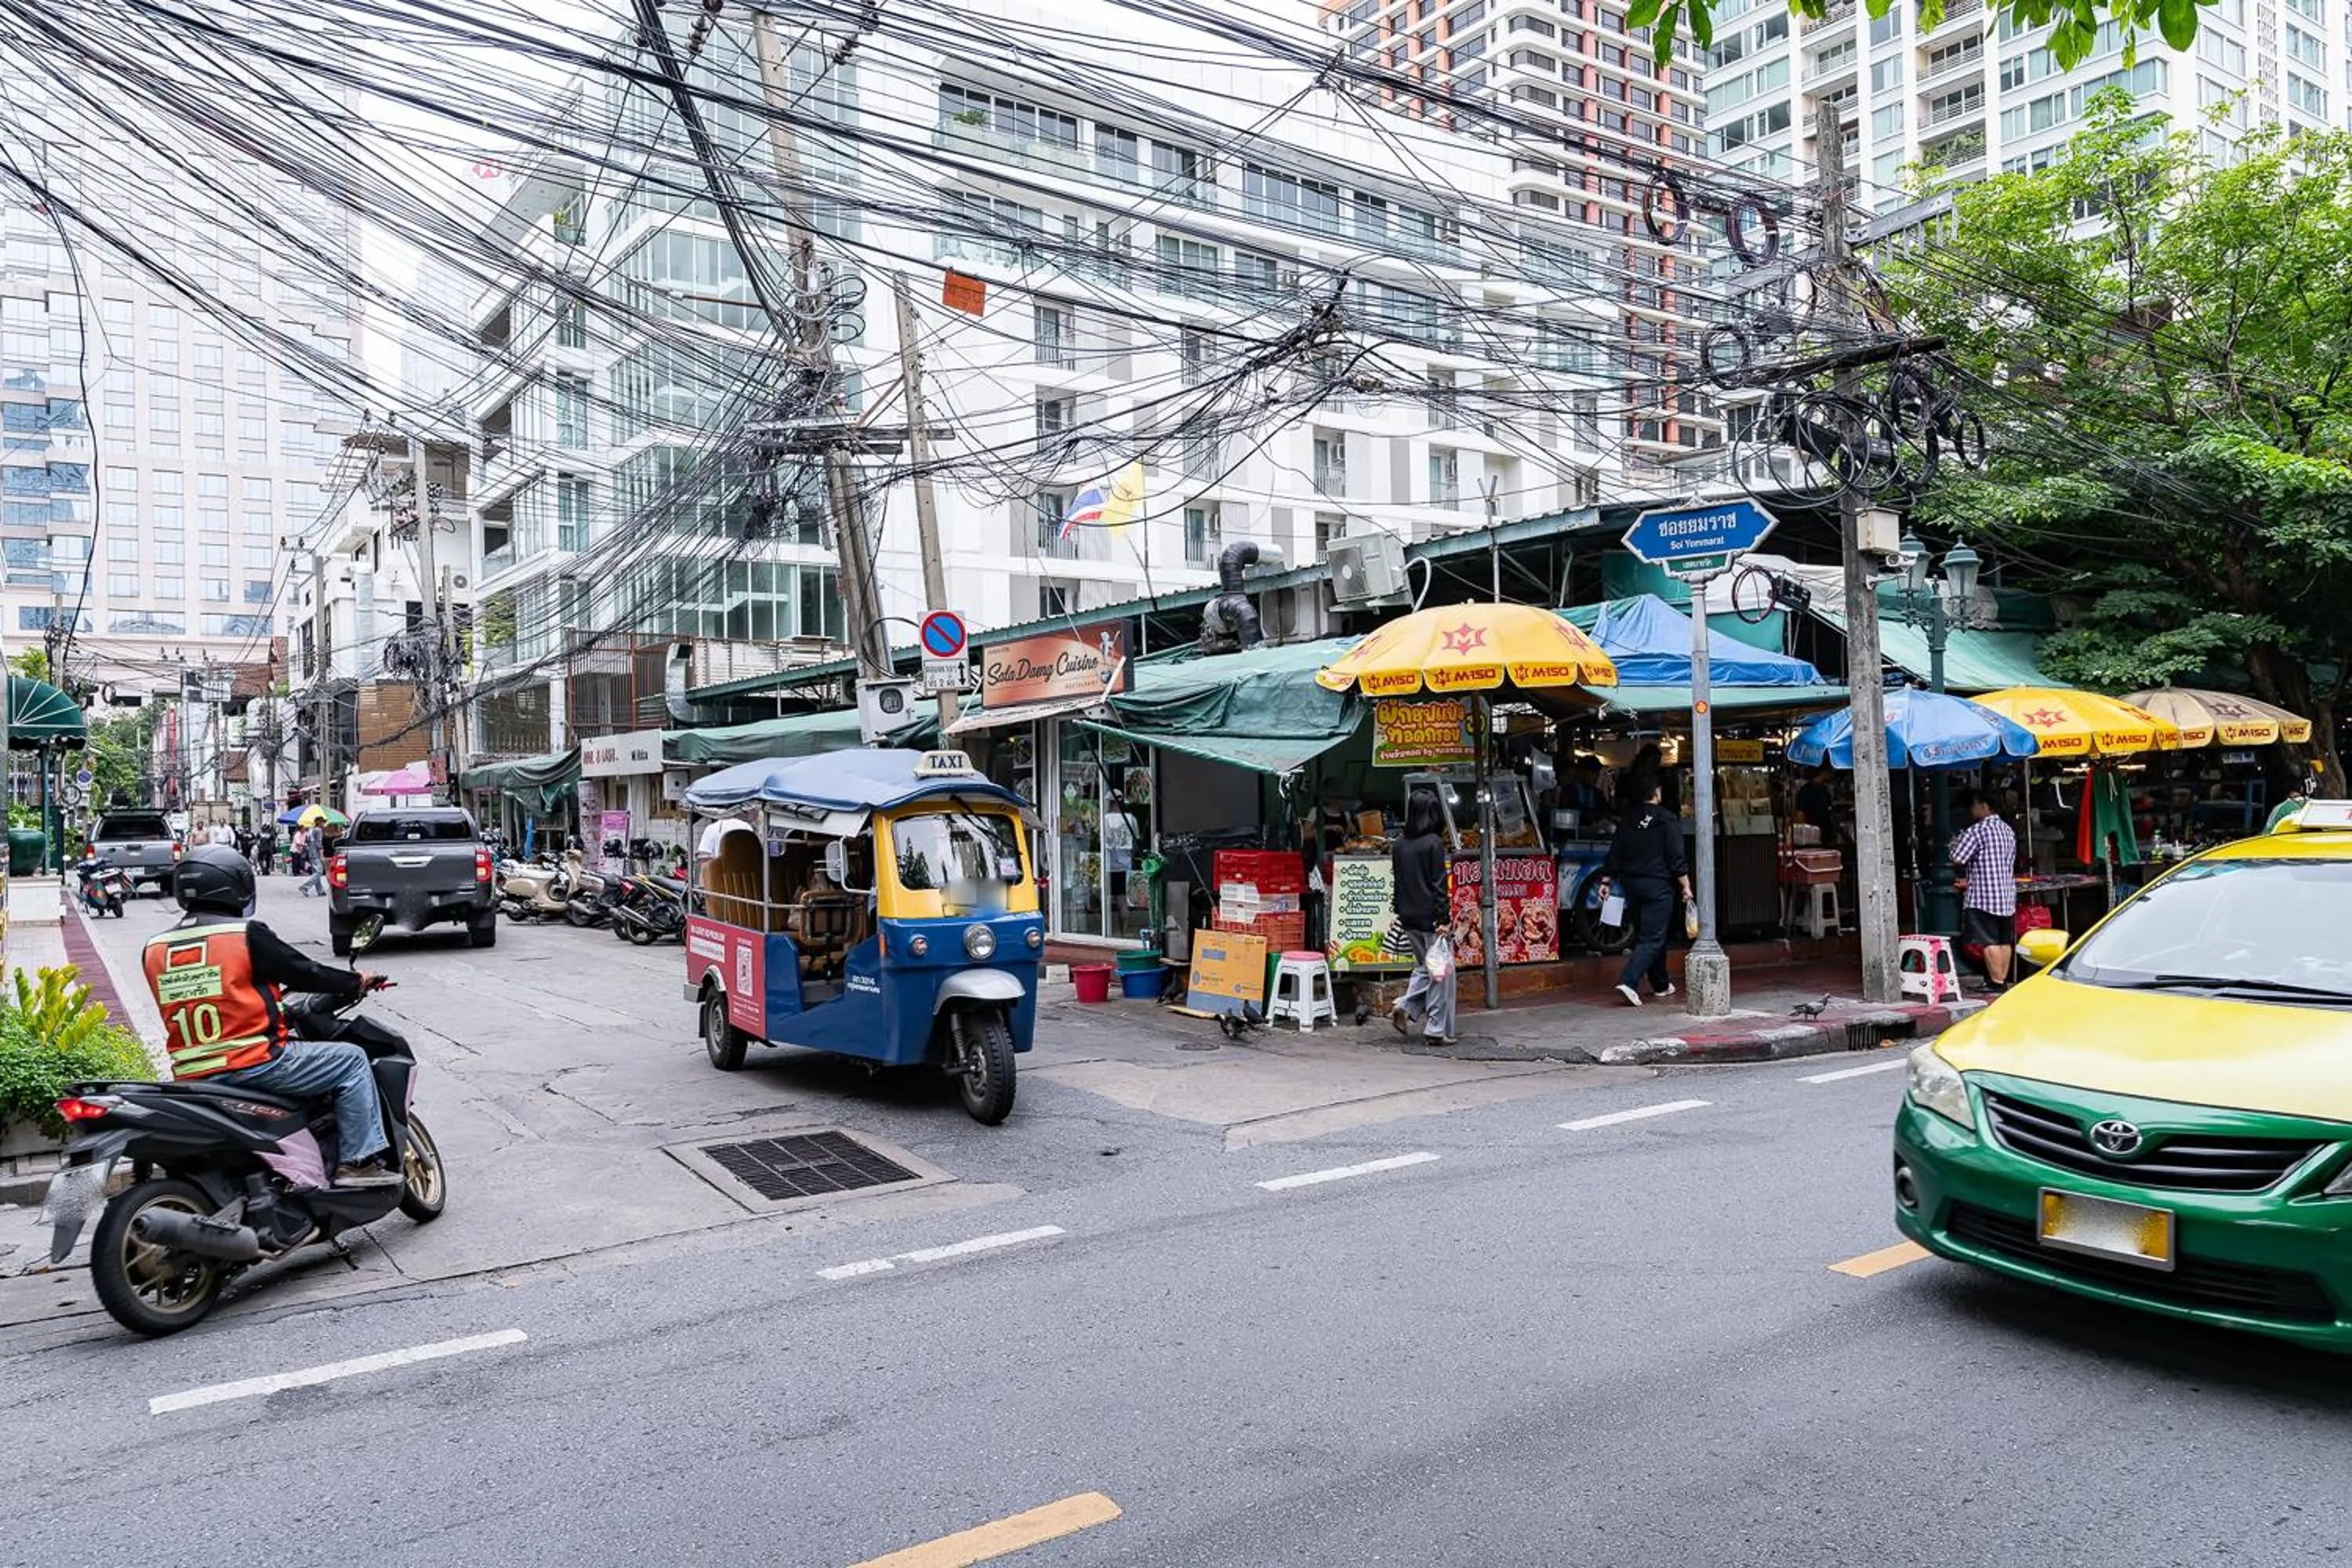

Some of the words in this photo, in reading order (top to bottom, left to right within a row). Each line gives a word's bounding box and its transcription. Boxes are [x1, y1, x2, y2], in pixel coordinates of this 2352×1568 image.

[1658, 512, 1737, 537] ซอยยมราช
[1670, 539, 1683, 550] Soi
[1685, 535, 1725, 549] Yommarat
[1056, 652, 1099, 676] Cuisine
[1386, 726, 1461, 743] ทอดกรอบ
[929, 755, 964, 769] TAXI
[172, 1004, 222, 1047] 10
